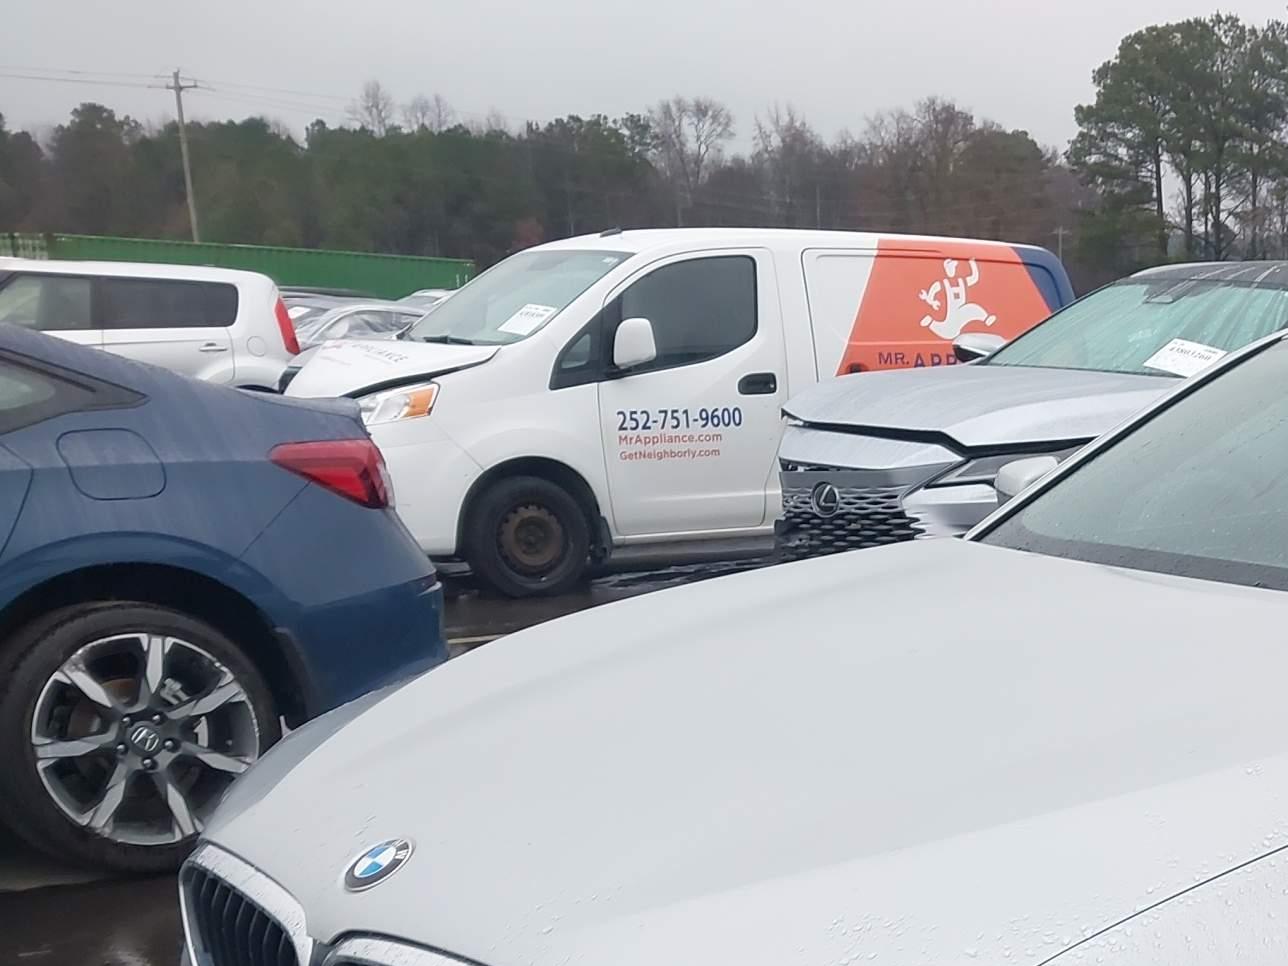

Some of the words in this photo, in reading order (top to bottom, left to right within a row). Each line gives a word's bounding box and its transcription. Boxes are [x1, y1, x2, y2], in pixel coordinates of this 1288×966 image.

[878, 351, 909, 365] MR.
[616, 407, 743, 431] 252-751-9600
[618, 432, 722, 446] MrAppliance.com
[619, 448, 721, 461] GetNeighborly.com
